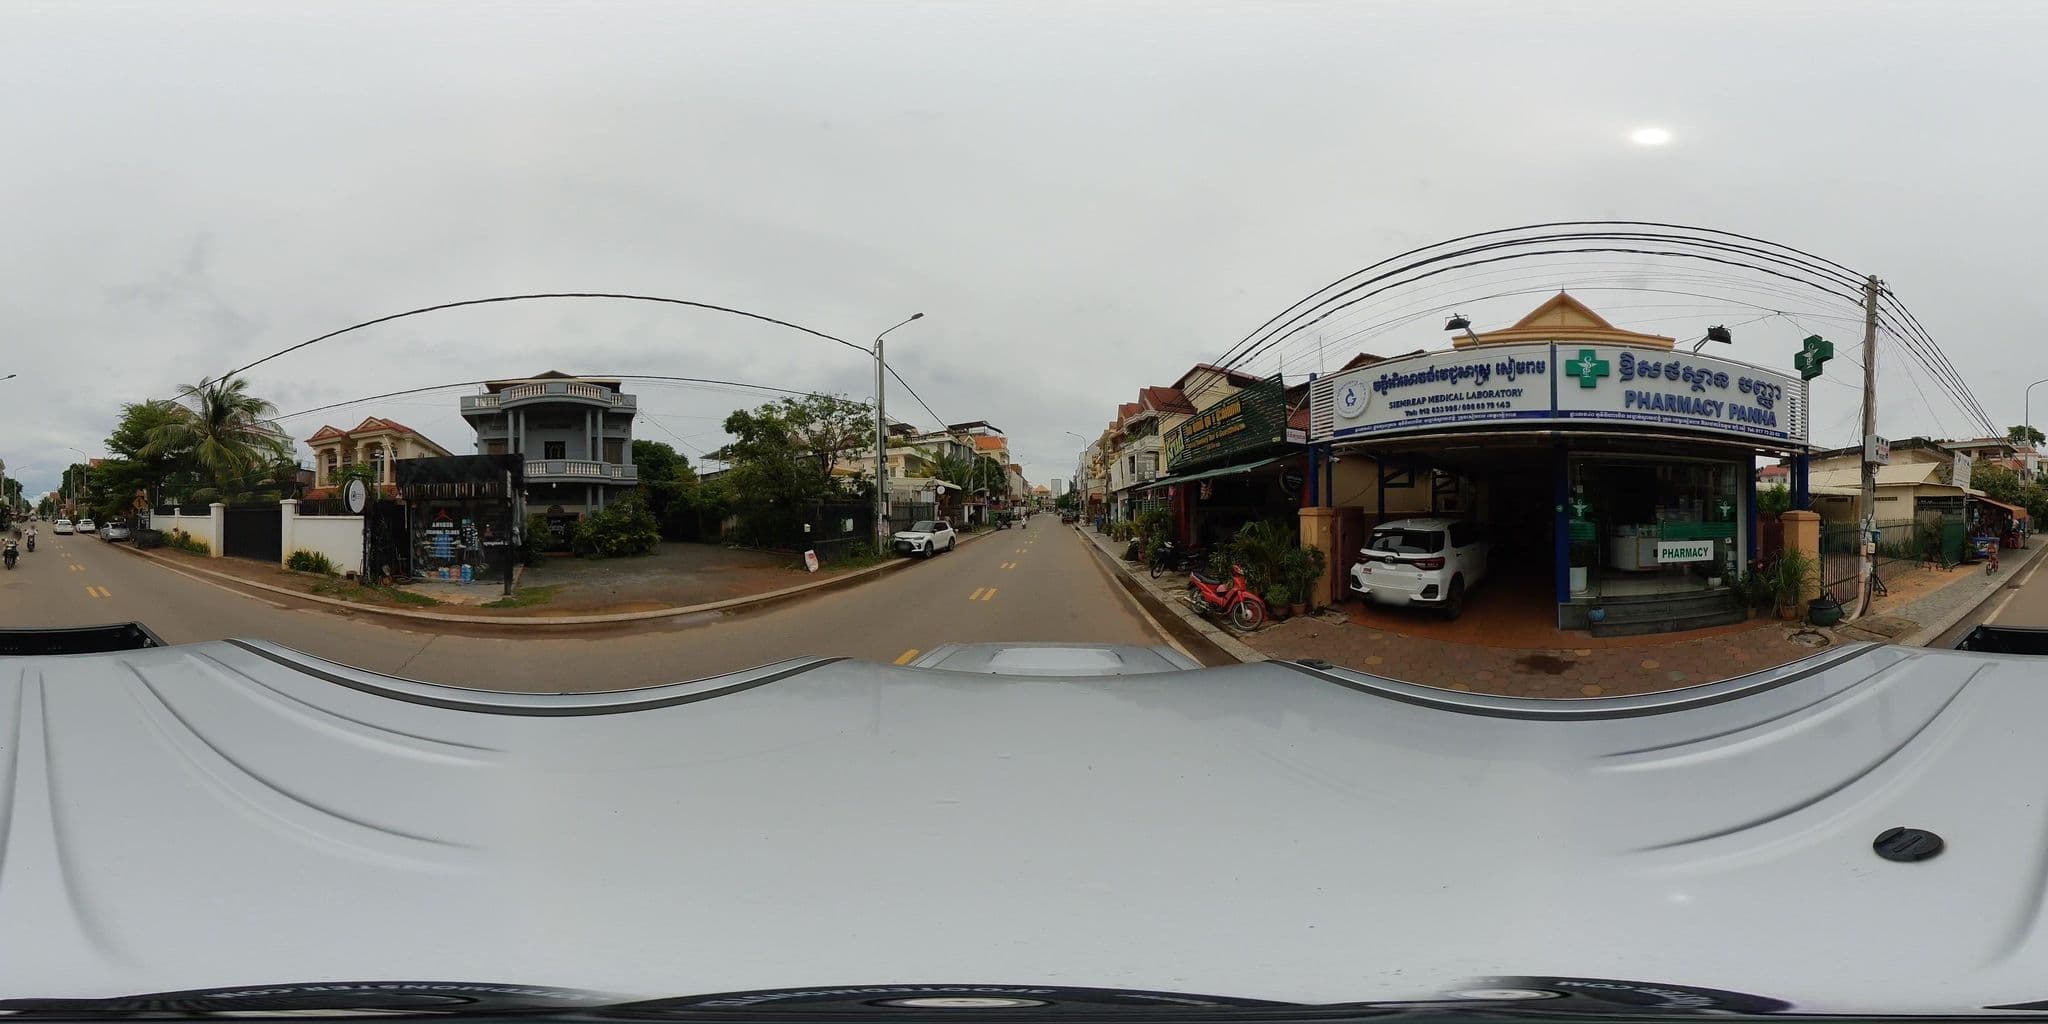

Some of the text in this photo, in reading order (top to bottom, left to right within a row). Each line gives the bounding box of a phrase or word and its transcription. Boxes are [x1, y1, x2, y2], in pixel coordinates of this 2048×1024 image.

[1495, 356, 1546, 382] សៀមរាប
[1389, 388, 1524, 410] SIEMREAP MEDICAL LABORATORY
[1624, 390, 1725, 418] PHARMACY
[1728, 403, 1778, 428] PANHA
[1662, 547, 1708, 558] PHARMACY
